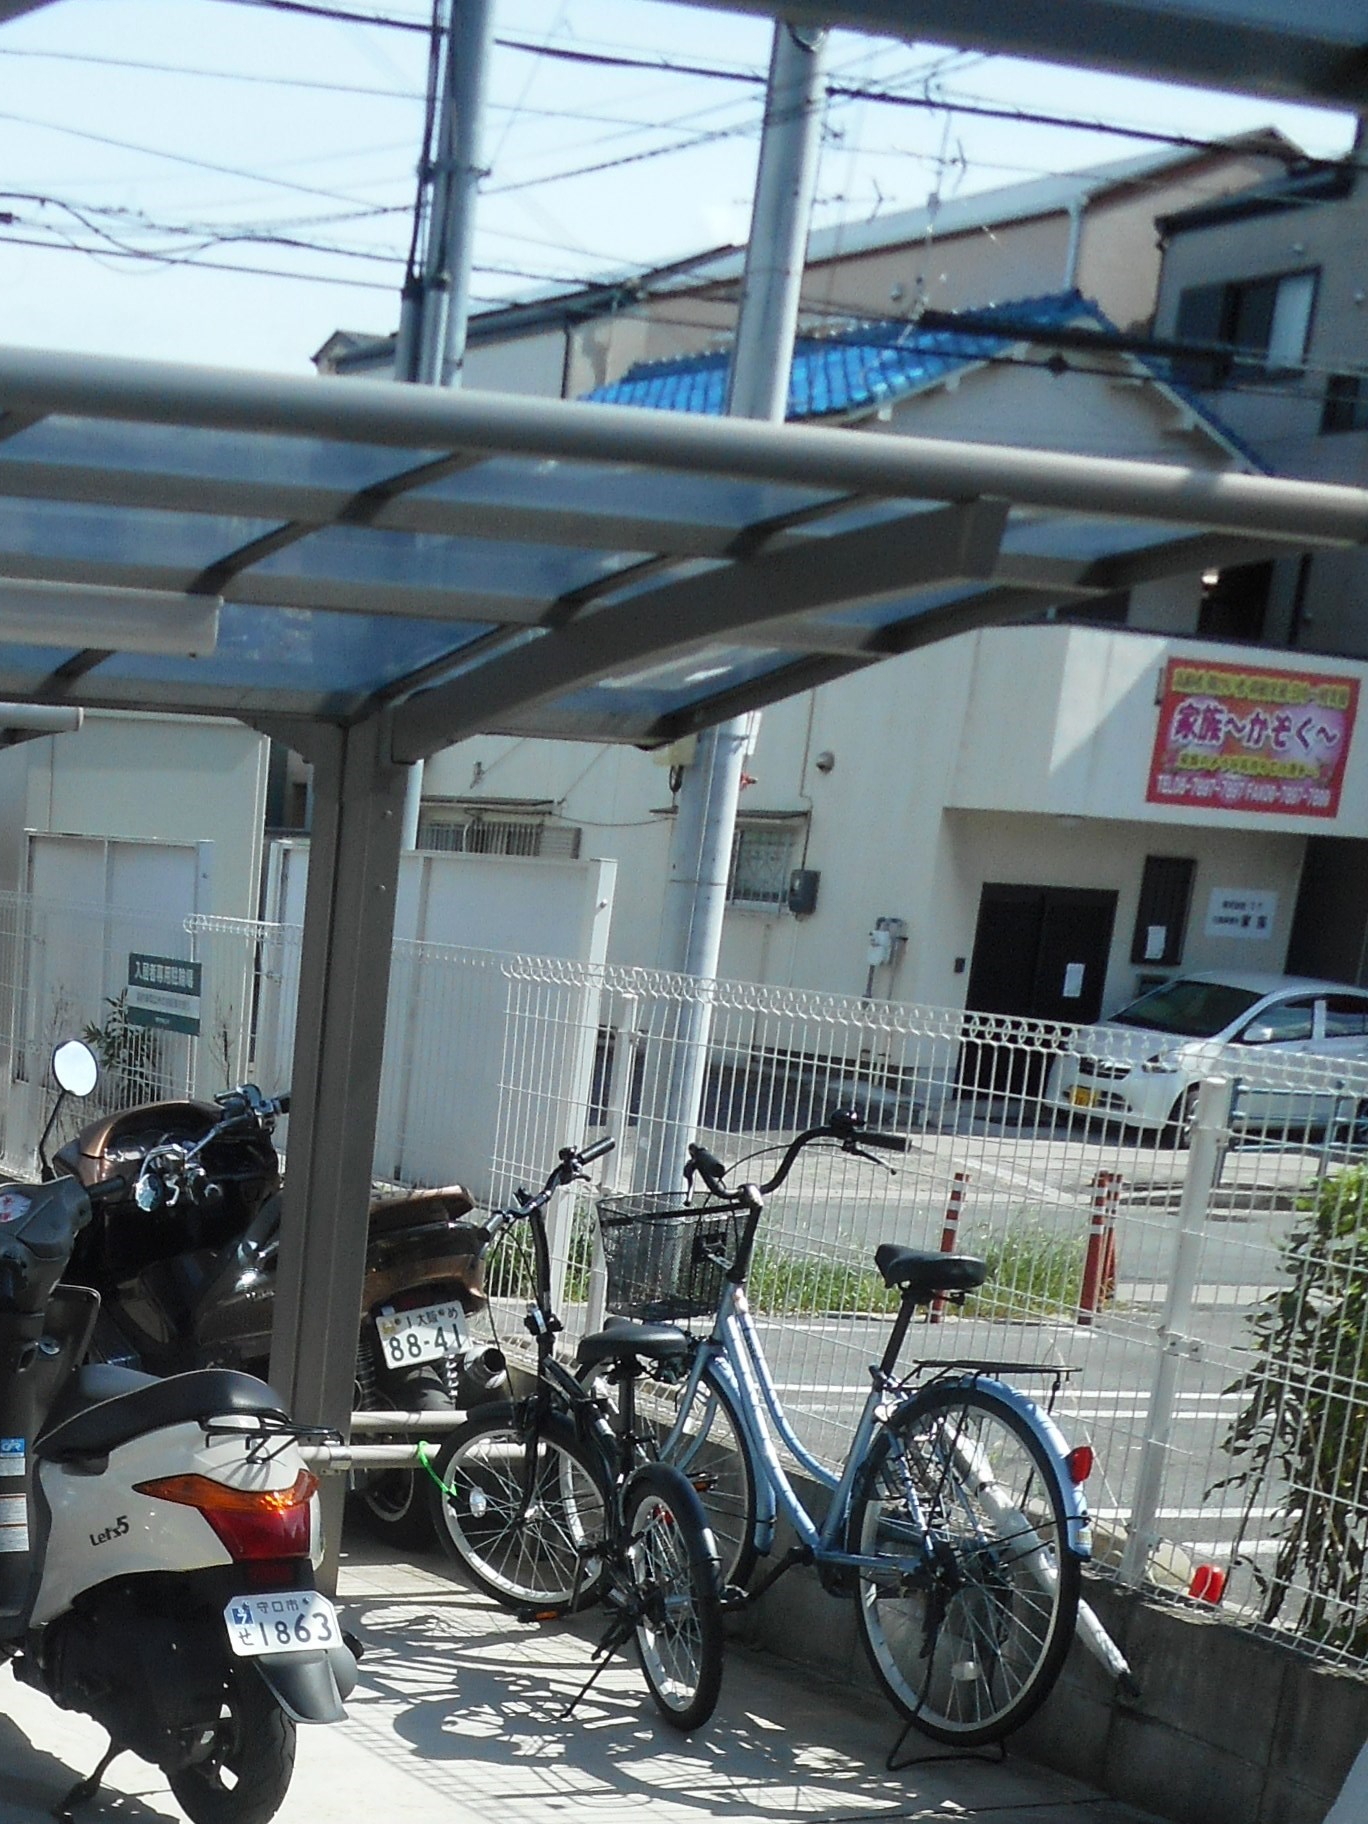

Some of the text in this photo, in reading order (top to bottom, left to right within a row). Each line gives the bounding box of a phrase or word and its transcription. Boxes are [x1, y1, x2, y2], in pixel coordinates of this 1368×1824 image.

[389, 1323, 462, 1362] 88-41
[256, 1599, 300, 1614] 守口市
[238, 1612, 332, 1647] せ 1863
